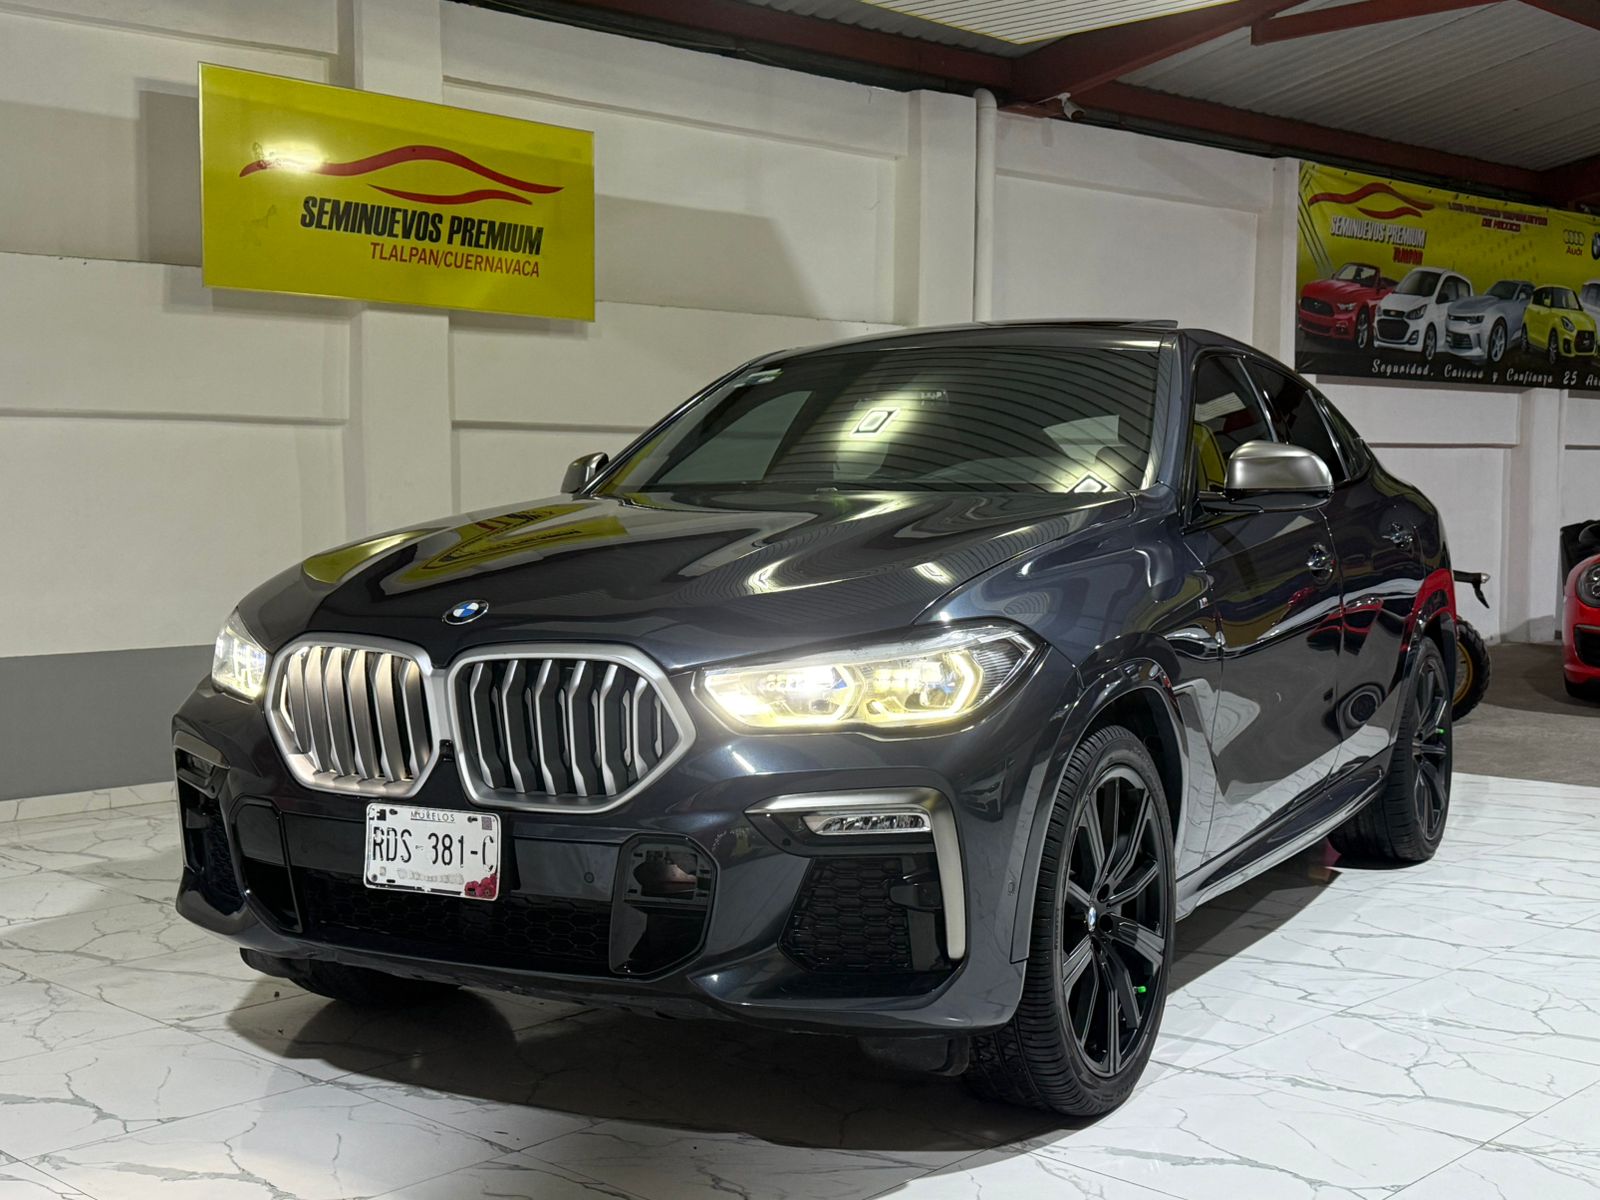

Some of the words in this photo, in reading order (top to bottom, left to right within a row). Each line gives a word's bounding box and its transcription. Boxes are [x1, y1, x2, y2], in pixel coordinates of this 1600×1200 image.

[300, 196, 443, 243] SEMINUEVOS
[447, 215, 544, 256] PREMIUM
[1330, 215, 1387, 244] SEMINUEVOS
[1387, 224, 1427, 249] PREMIUM
[370, 242, 540, 278] TLALPAN/CUERNAVACA
[1562, 370, 1578, 386] 25
